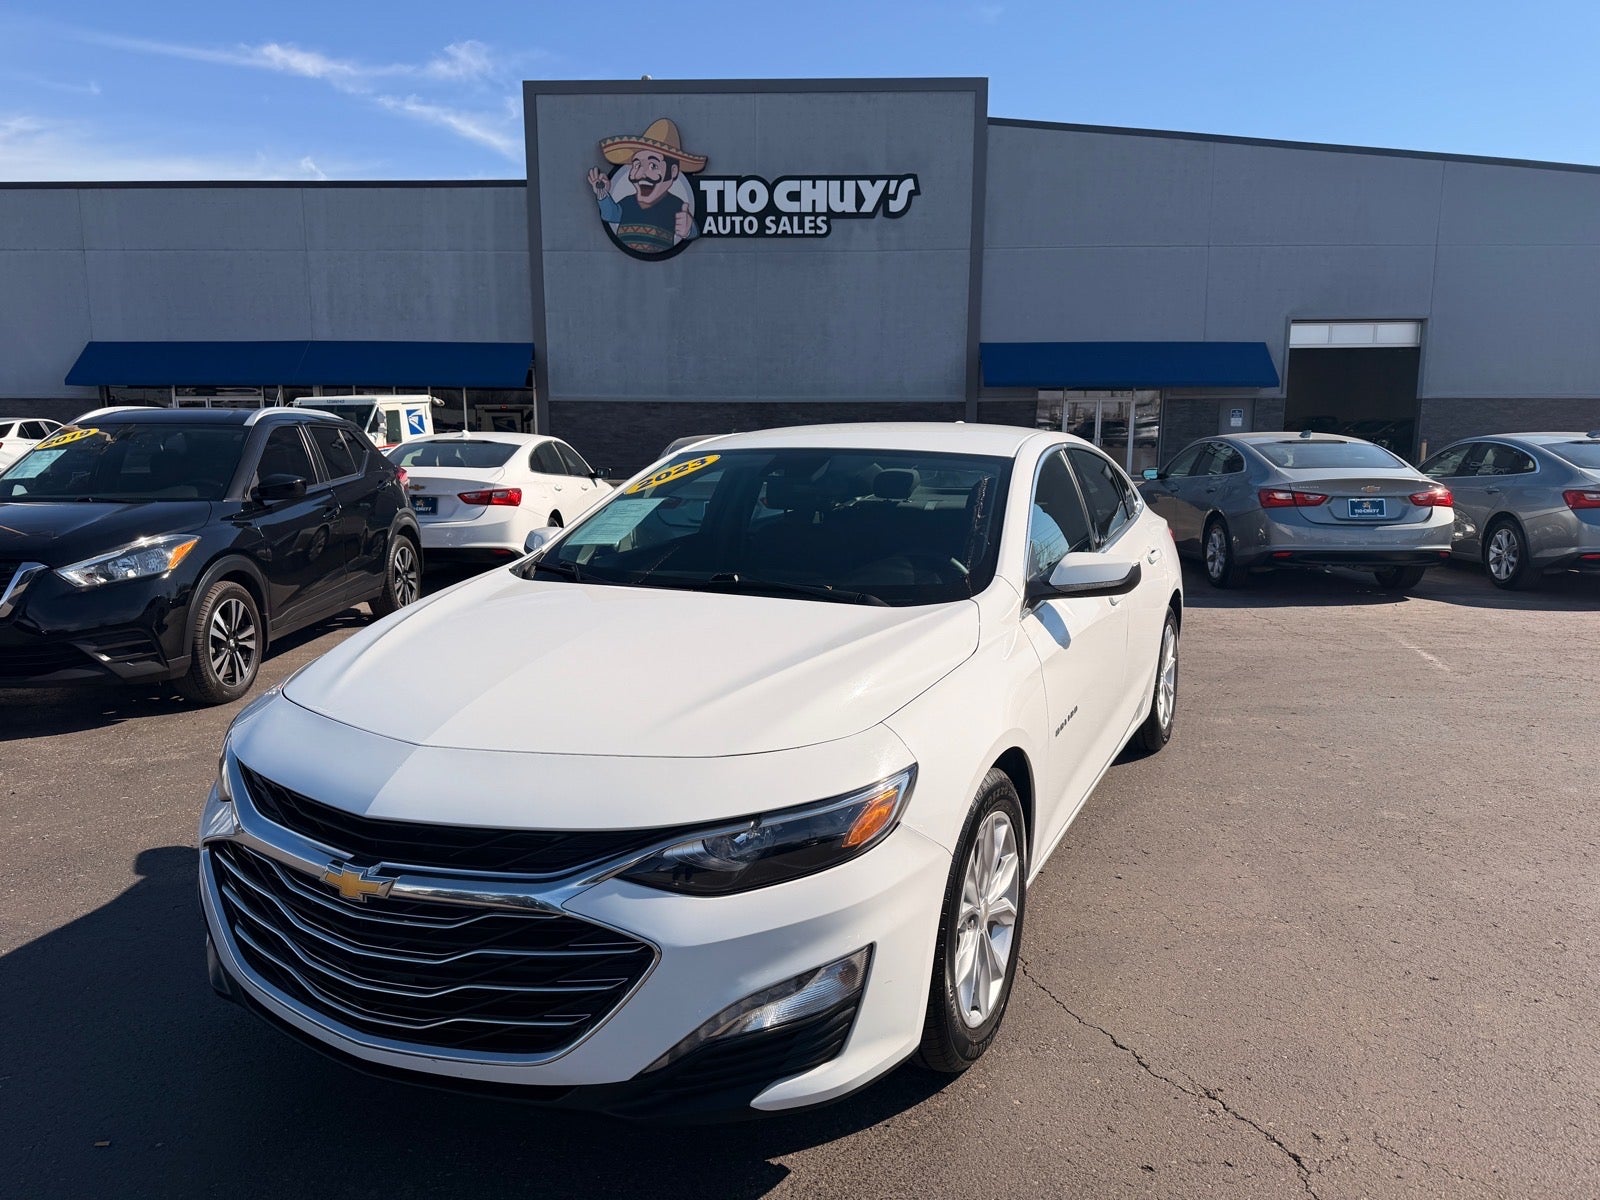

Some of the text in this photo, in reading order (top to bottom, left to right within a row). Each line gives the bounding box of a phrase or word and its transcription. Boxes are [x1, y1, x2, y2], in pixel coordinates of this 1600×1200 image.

[699, 178, 915, 213] TIO CHUY'S
[702, 216, 828, 235] AUTO SALES
[636, 457, 708, 491] 2023
